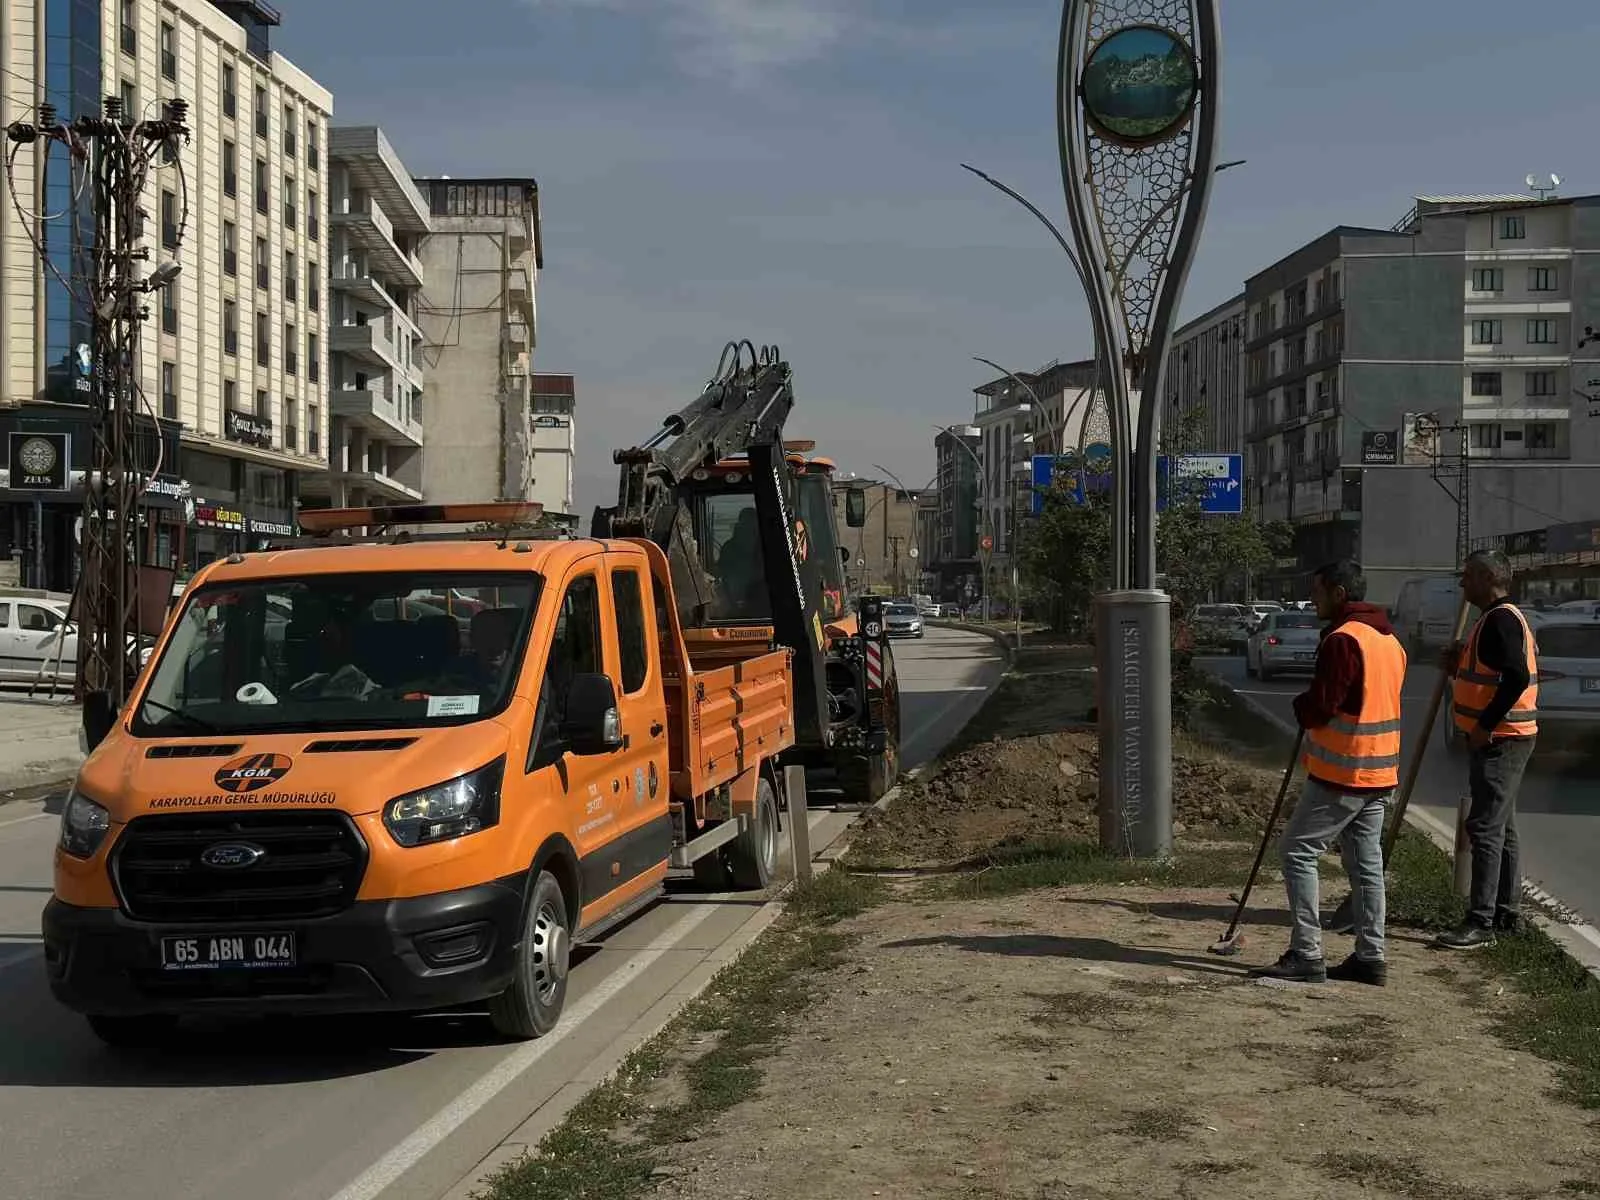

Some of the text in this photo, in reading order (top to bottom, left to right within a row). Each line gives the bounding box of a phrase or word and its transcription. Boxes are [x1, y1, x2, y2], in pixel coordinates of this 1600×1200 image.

[23, 475, 52, 484] ZEUS
[231, 768, 271, 778] KGM
[149, 791, 336, 808] KARAYOLLARI GENEL MÜDÜRLÜĞÜ
[175, 937, 290, 962] 65 ABN 044
